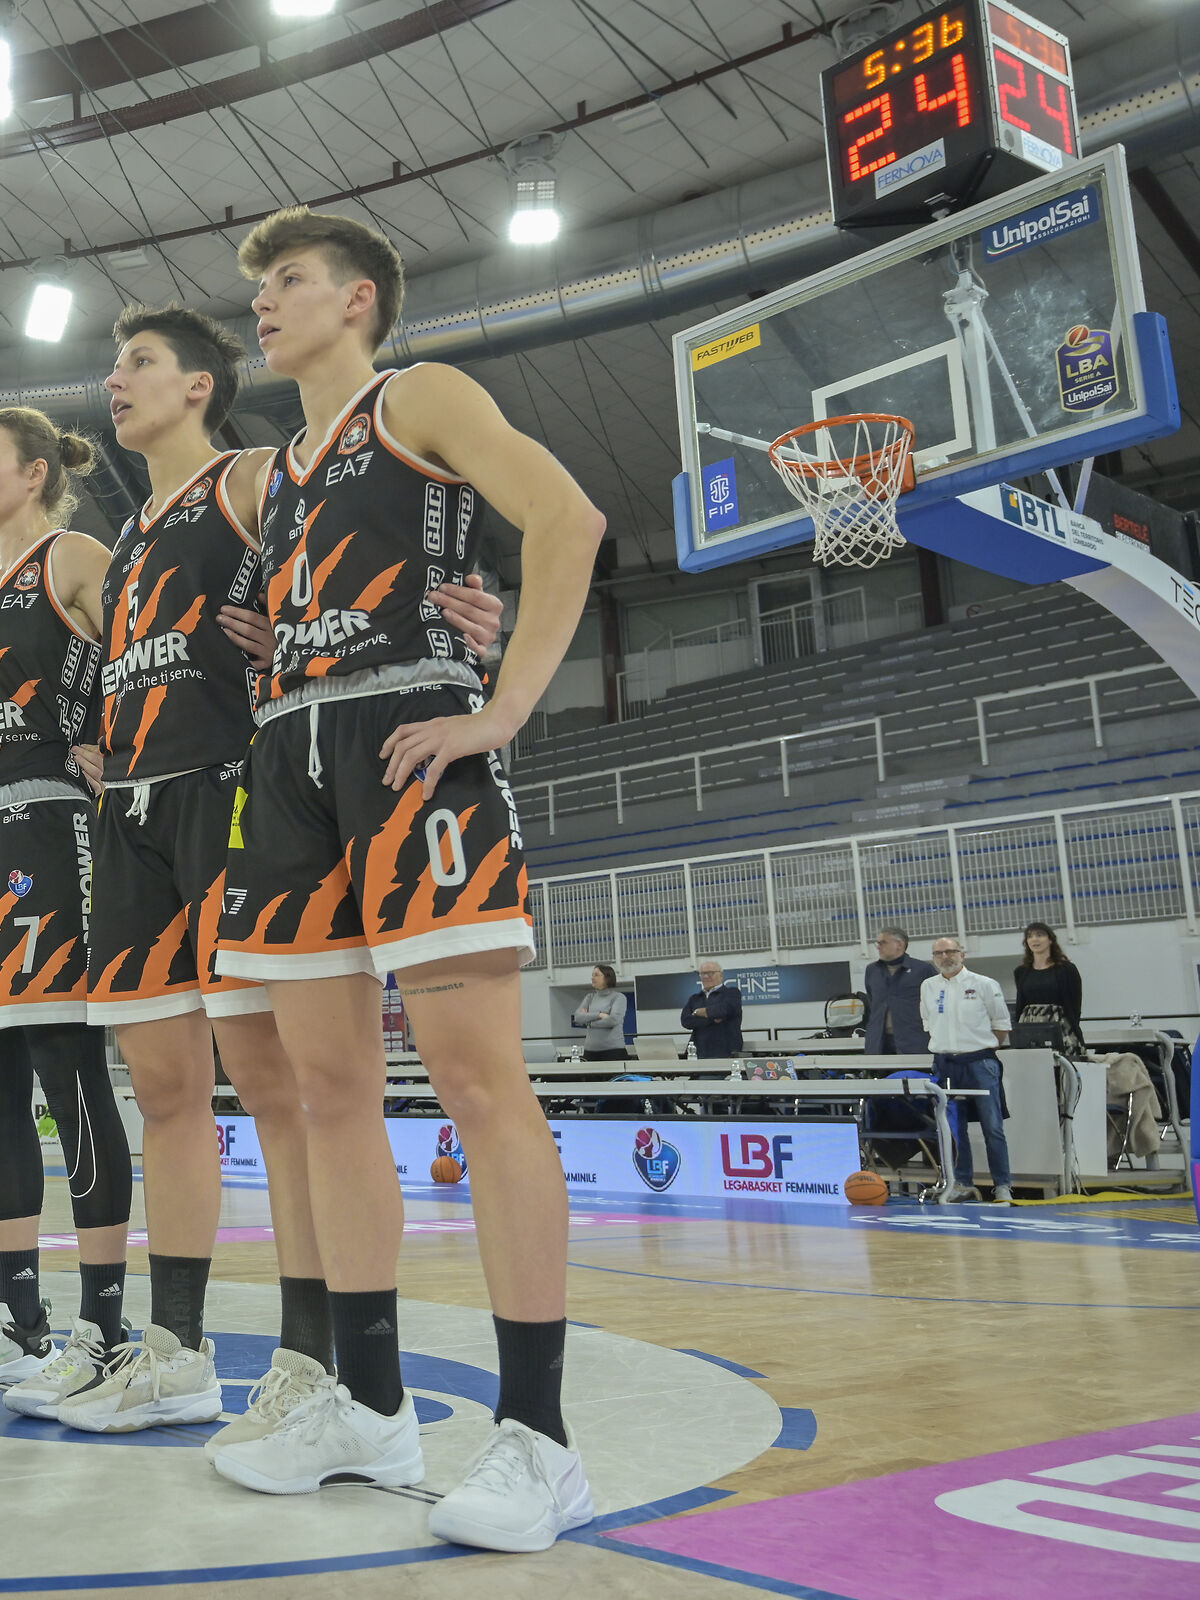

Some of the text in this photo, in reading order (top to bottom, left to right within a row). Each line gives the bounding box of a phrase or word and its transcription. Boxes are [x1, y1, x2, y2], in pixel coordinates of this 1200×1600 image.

[994, 49, 1073, 154] 24
[844, 53, 971, 182] 24
[877, 147, 944, 190] FERNOVA
[991, 195, 1090, 247] UnipolSai
[1033, 214, 1091, 241] ASSICURAZIONI
[697, 331, 754, 360] FASTWEB
[1065, 354, 1110, 379] LBA
[1067, 382, 1112, 402] UnipolSai
[325, 451, 374, 487] EA7
[164, 506, 208, 529] EA7
[708, 502, 735, 518] FIP
[1020, 493, 1066, 539] BTL
[291, 551, 313, 607] 0
[0, 593, 40, 609] EA7
[127, 581, 139, 632] 5
[349, 633, 392, 655] serve.
[137, 668, 207, 689] che ti serve.
[5, 732, 41, 743] serve.
[3, 813, 31, 824] BITRE
[424, 808, 467, 887] 0
[13, 916, 40, 974] 7
[736, 970, 779, 978] METROLOGIA
[230, 1157, 257, 1167] FEMMINILE
[646, 1159, 669, 1175] LBF
[720, 1133, 793, 1179] LBF
[723, 1179, 839, 1195] LEGABASKET FEMMINILE
